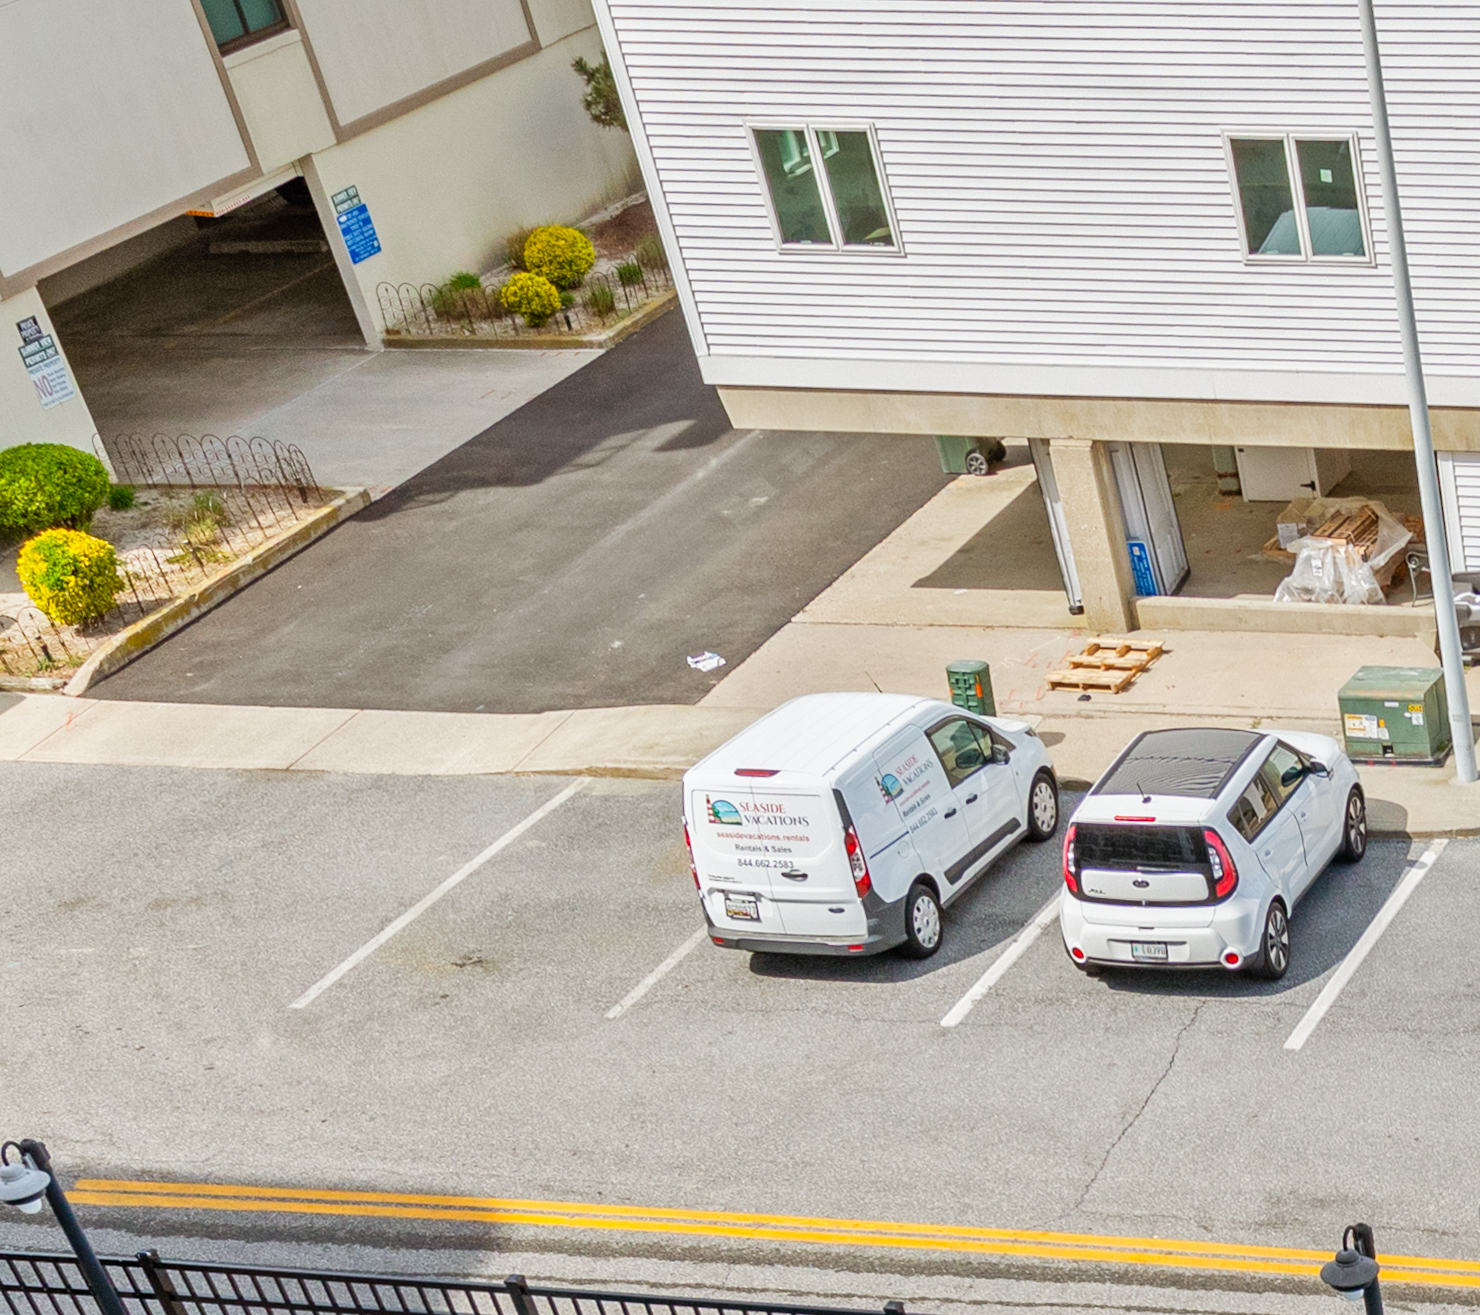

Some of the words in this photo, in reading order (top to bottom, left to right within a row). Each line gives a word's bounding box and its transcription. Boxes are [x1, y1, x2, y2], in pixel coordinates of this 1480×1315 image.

[33, 375, 53, 400] NO
[740, 802, 786, 814] SEASIDE
[744, 814, 810, 827] VACATIONS
[716, 832, 810, 842] seasidevacations.rentals
[735, 844, 762, 852] Rentals
[772, 846, 792, 854] Sales
[737, 858, 794, 869] 844.662.2583
